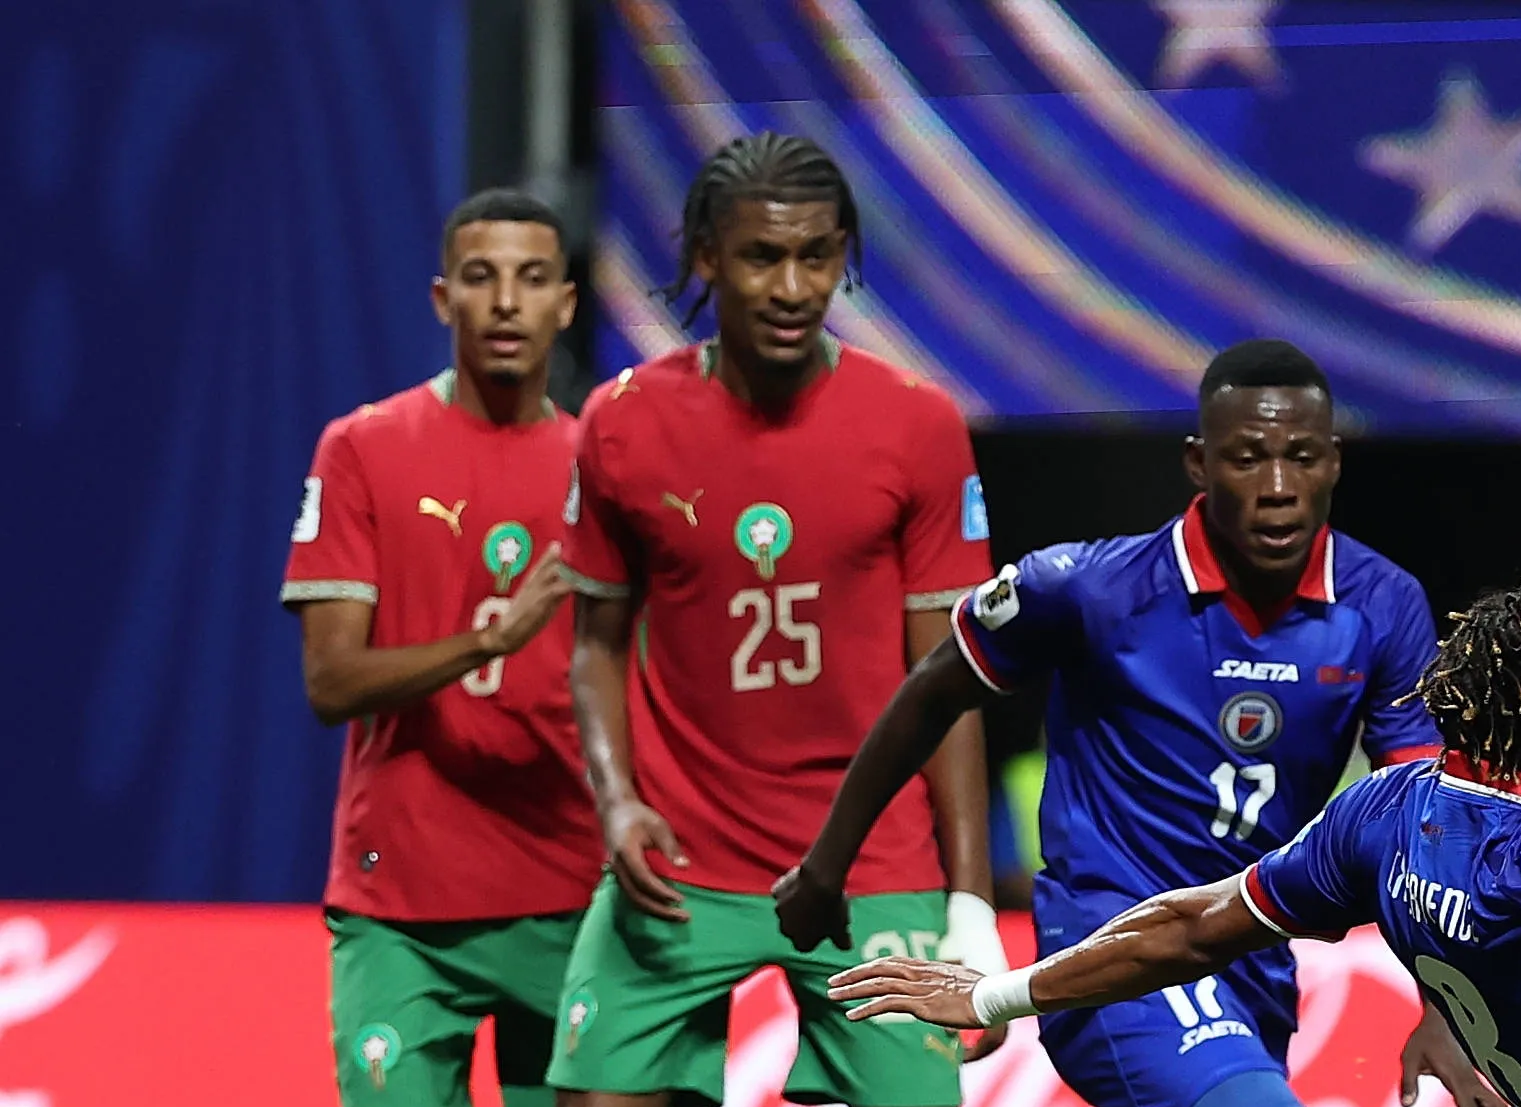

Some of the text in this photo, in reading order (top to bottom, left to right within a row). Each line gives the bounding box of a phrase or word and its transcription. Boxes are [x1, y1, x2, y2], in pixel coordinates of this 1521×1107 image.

[726, 582, 823, 692] 25
[1213, 660, 1299, 682] SAETA
[1210, 761, 1276, 840] 17
[1178, 1020, 1253, 1055] SAETA
